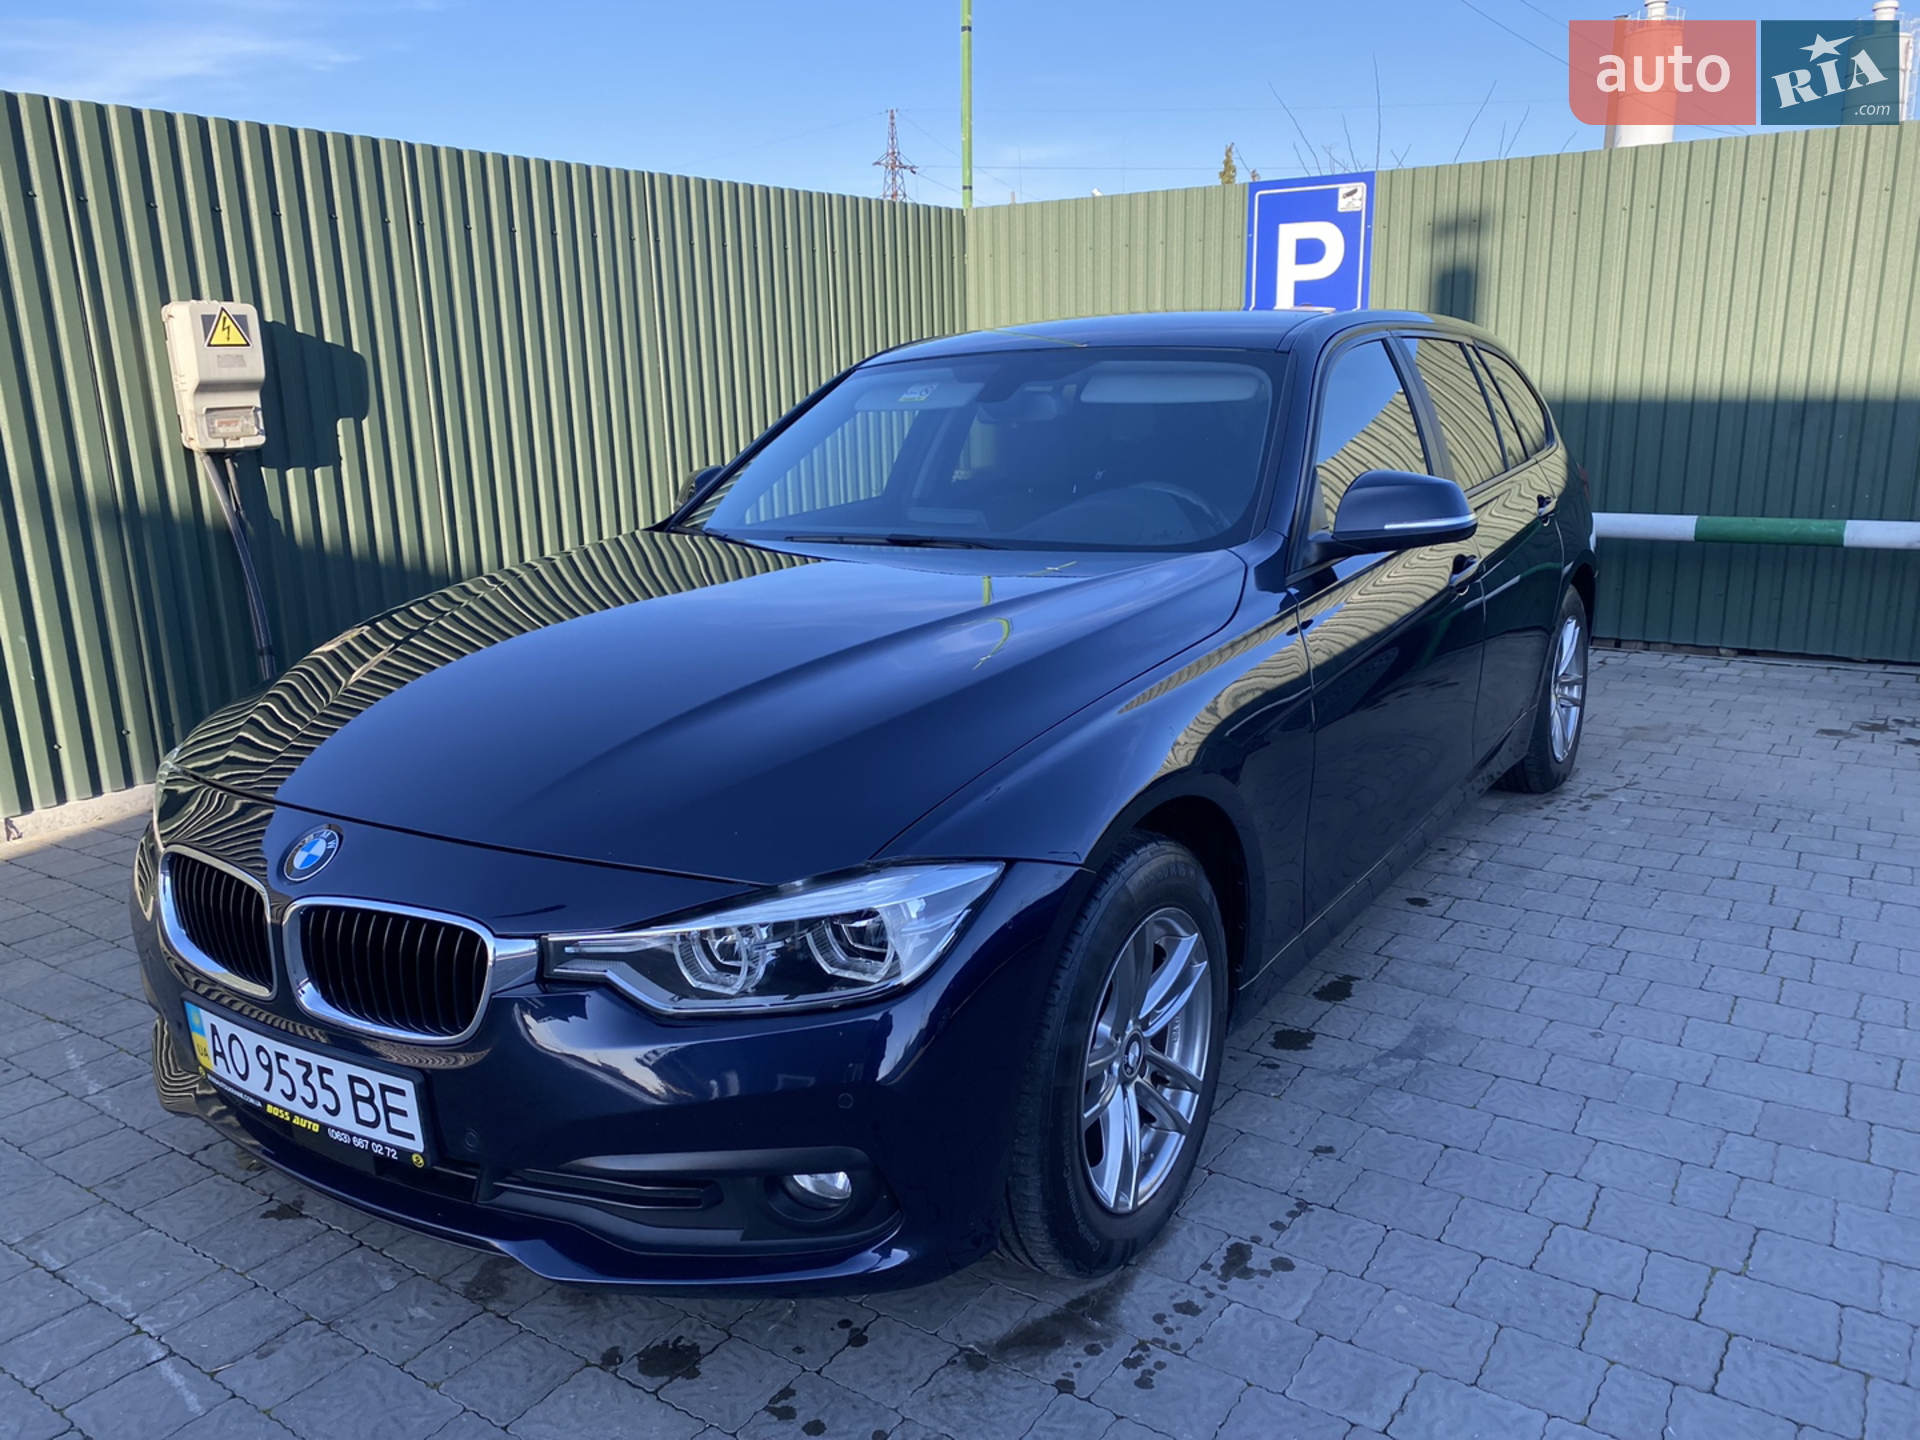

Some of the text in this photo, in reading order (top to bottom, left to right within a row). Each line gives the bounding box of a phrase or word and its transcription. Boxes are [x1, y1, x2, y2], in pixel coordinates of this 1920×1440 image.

[1275, 221, 1345, 309] P
[197, 1043, 210, 1060] UA
[210, 1023, 250, 1082] AO
[255, 1045, 341, 1117] 9535
[347, 1074, 415, 1141] BE
[266, 1104, 320, 1133] BOSS AUTO
